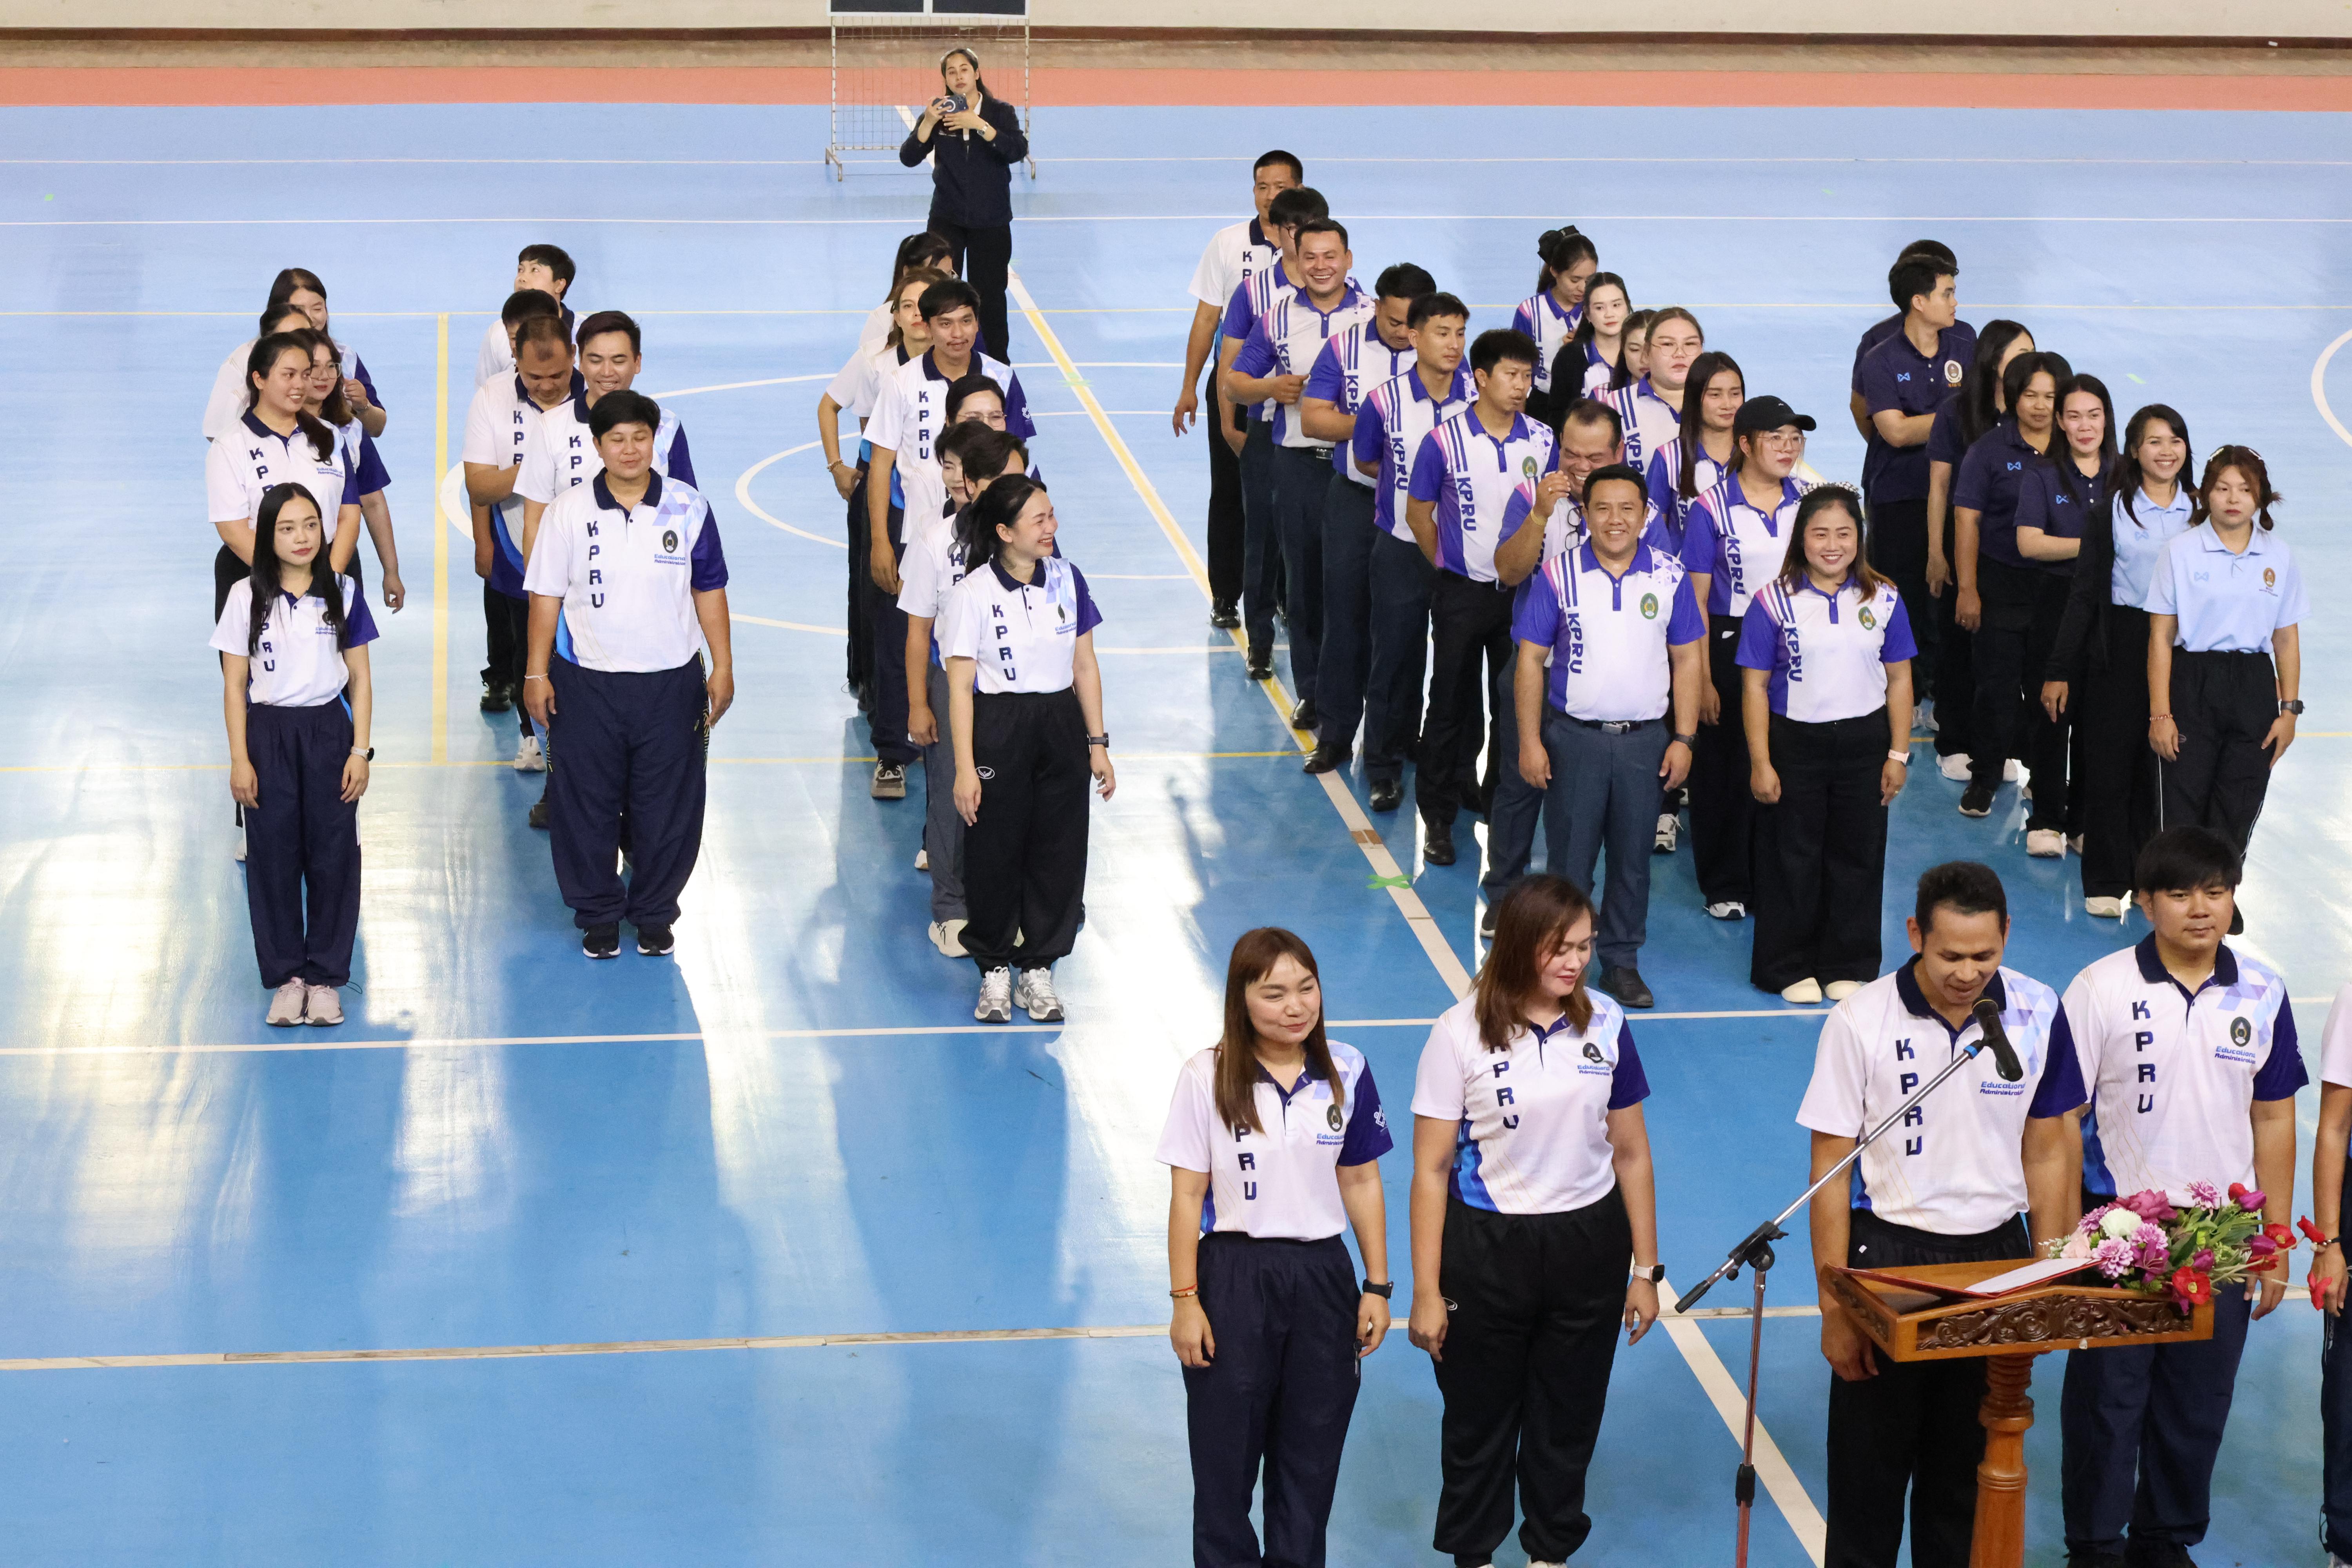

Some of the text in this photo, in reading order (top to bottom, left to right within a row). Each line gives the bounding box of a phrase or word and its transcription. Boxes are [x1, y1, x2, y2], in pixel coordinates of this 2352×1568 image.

[1243, 251, 1252, 279] KP
[919, 391, 929, 459] KPRU
[249, 447, 274, 495] KP
[1391, 437, 1408, 491] KPRU
[1456, 477, 1477, 531] KPRU
[586, 521, 604, 608] KPRU
[1726, 537, 1746, 595] KPRU
[260, 622, 275, 671] PRU
[992, 604, 1016, 681] KPRU
[1568, 613, 1584, 675] KPRU
[1784, 627, 1802, 682] KPRU
[2132, 1000, 2156, 1114] KPRU
[2216, 1045, 2256, 1058] Educationa
[1234, 1123, 1257, 1200] PRU
